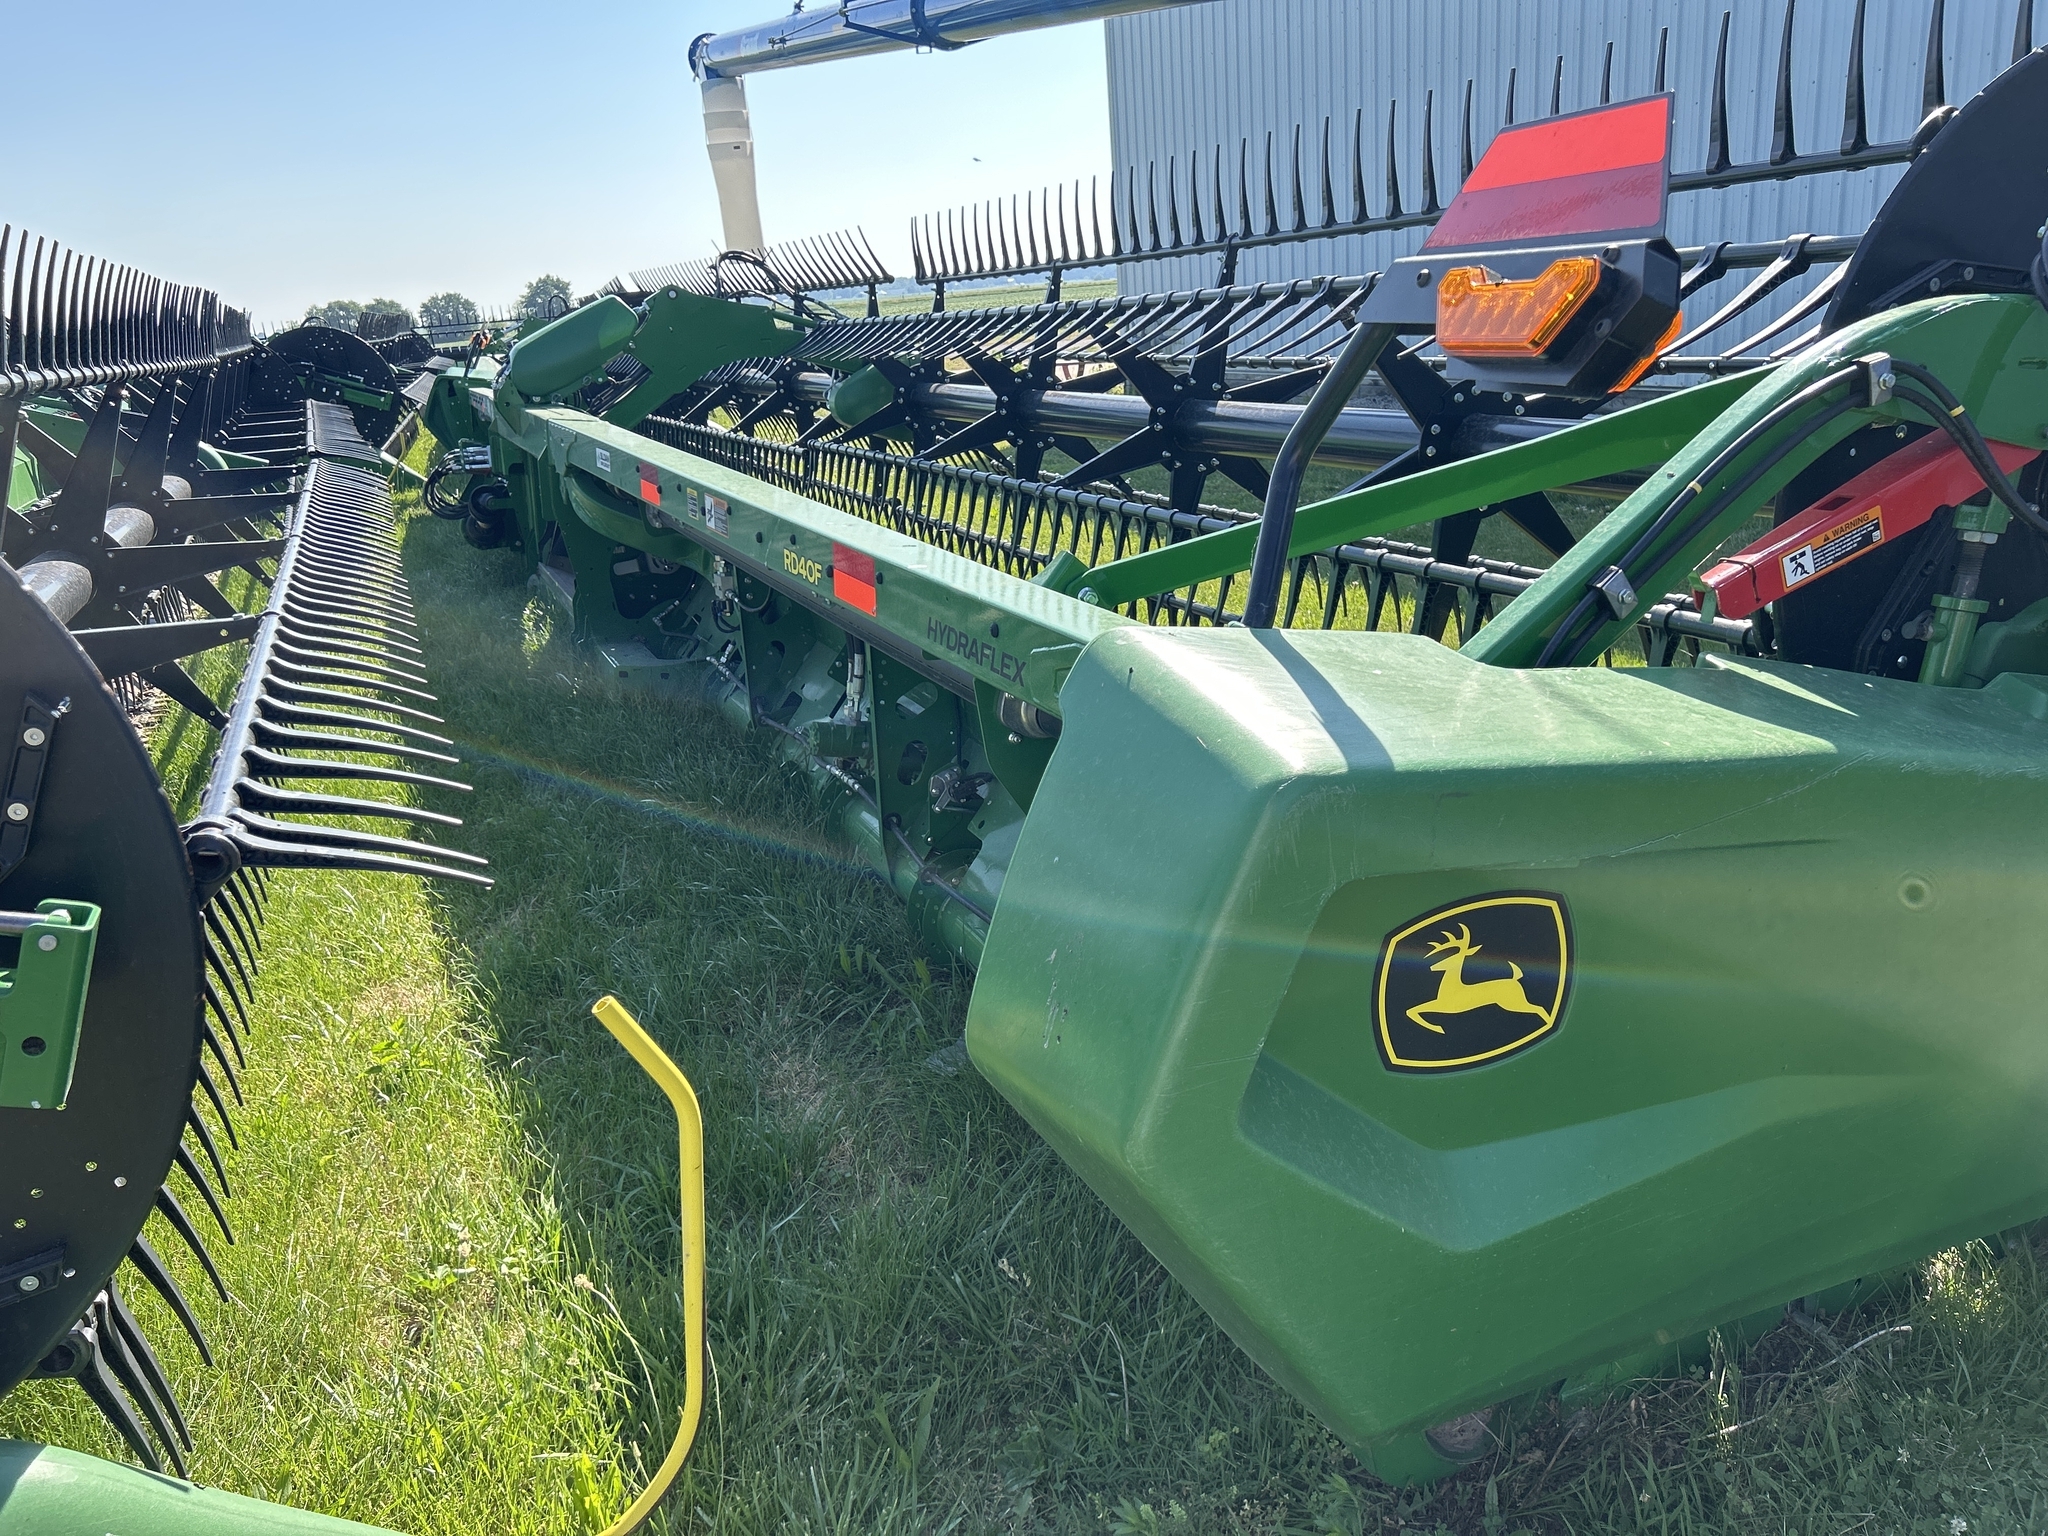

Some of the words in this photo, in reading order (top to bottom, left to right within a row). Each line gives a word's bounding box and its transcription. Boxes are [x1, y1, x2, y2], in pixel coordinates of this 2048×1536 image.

[1832, 513, 1870, 538] WARNING
[783, 548, 823, 586] RD40F
[927, 616, 1027, 688] HYDRAFLEX
